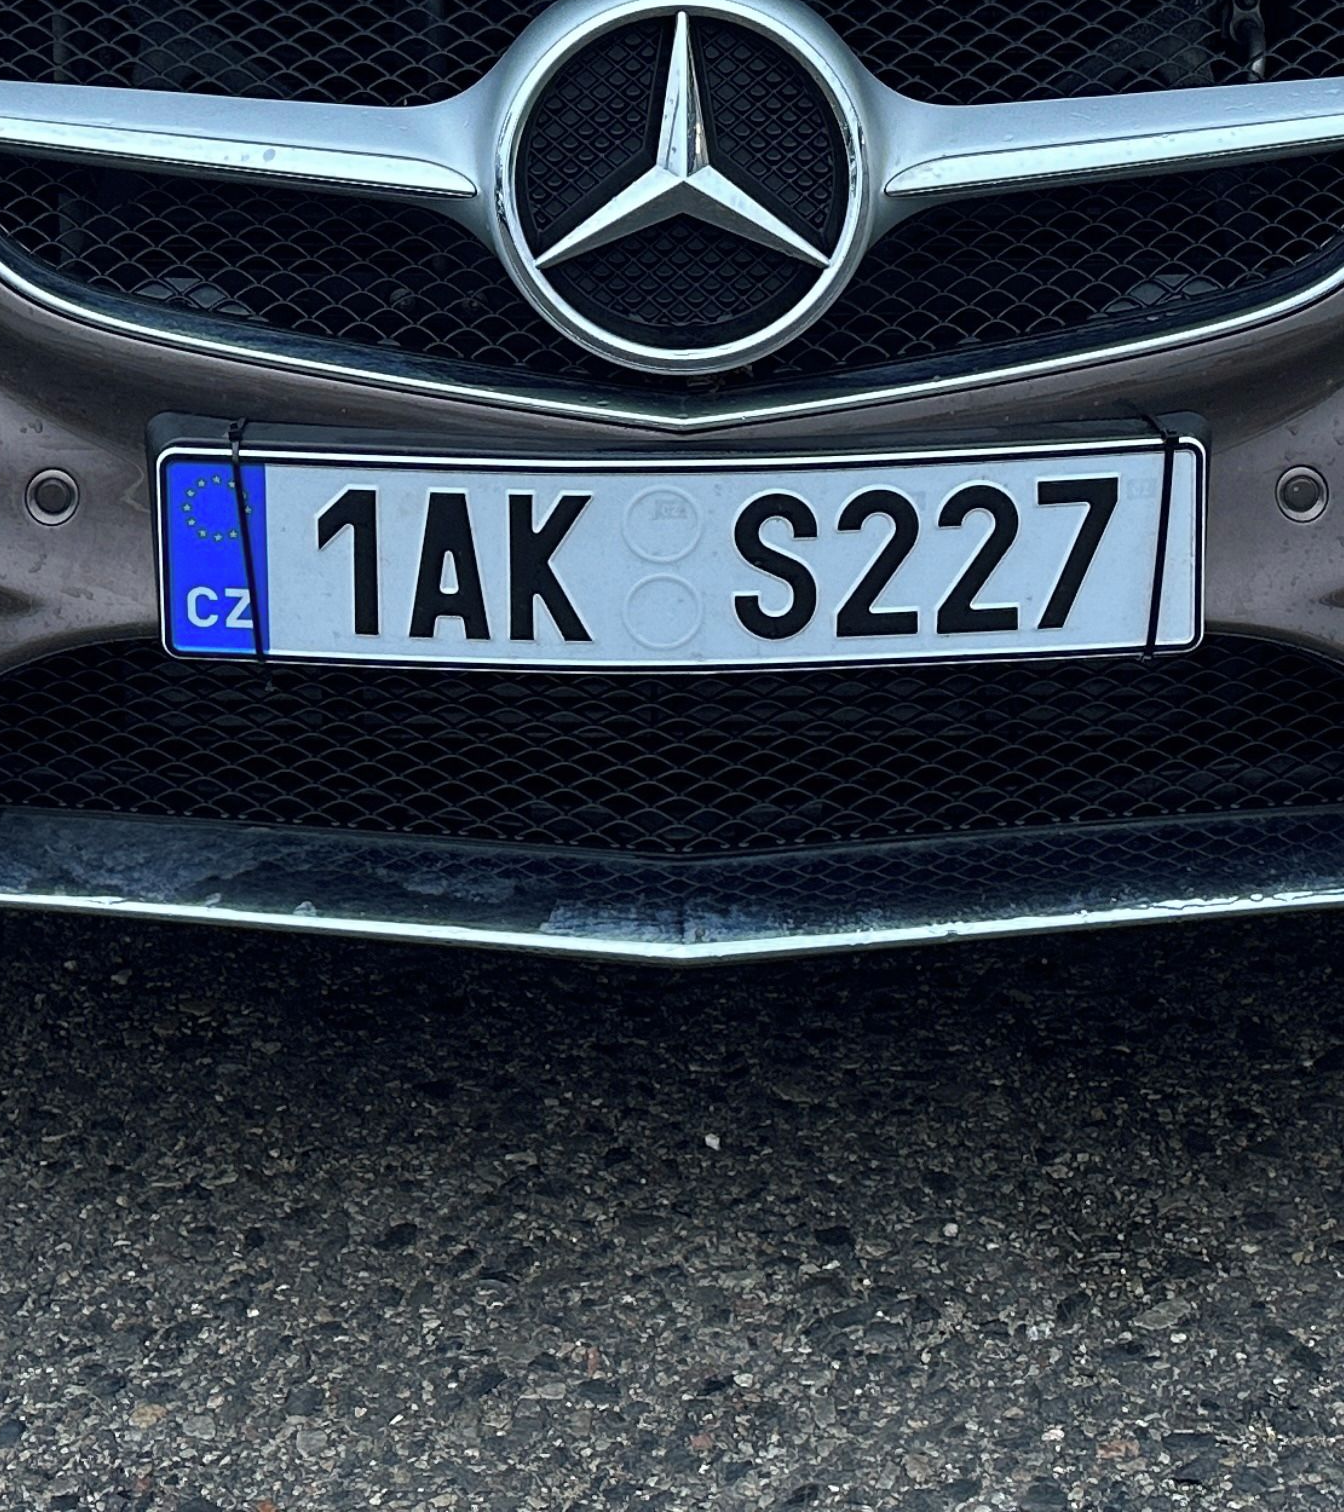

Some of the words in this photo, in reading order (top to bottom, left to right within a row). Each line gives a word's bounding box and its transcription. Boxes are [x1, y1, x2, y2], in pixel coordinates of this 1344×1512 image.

[187, 586, 254, 629] CZ
[316, 486, 594, 643] 1AK
[732, 477, 1120, 643] S227
